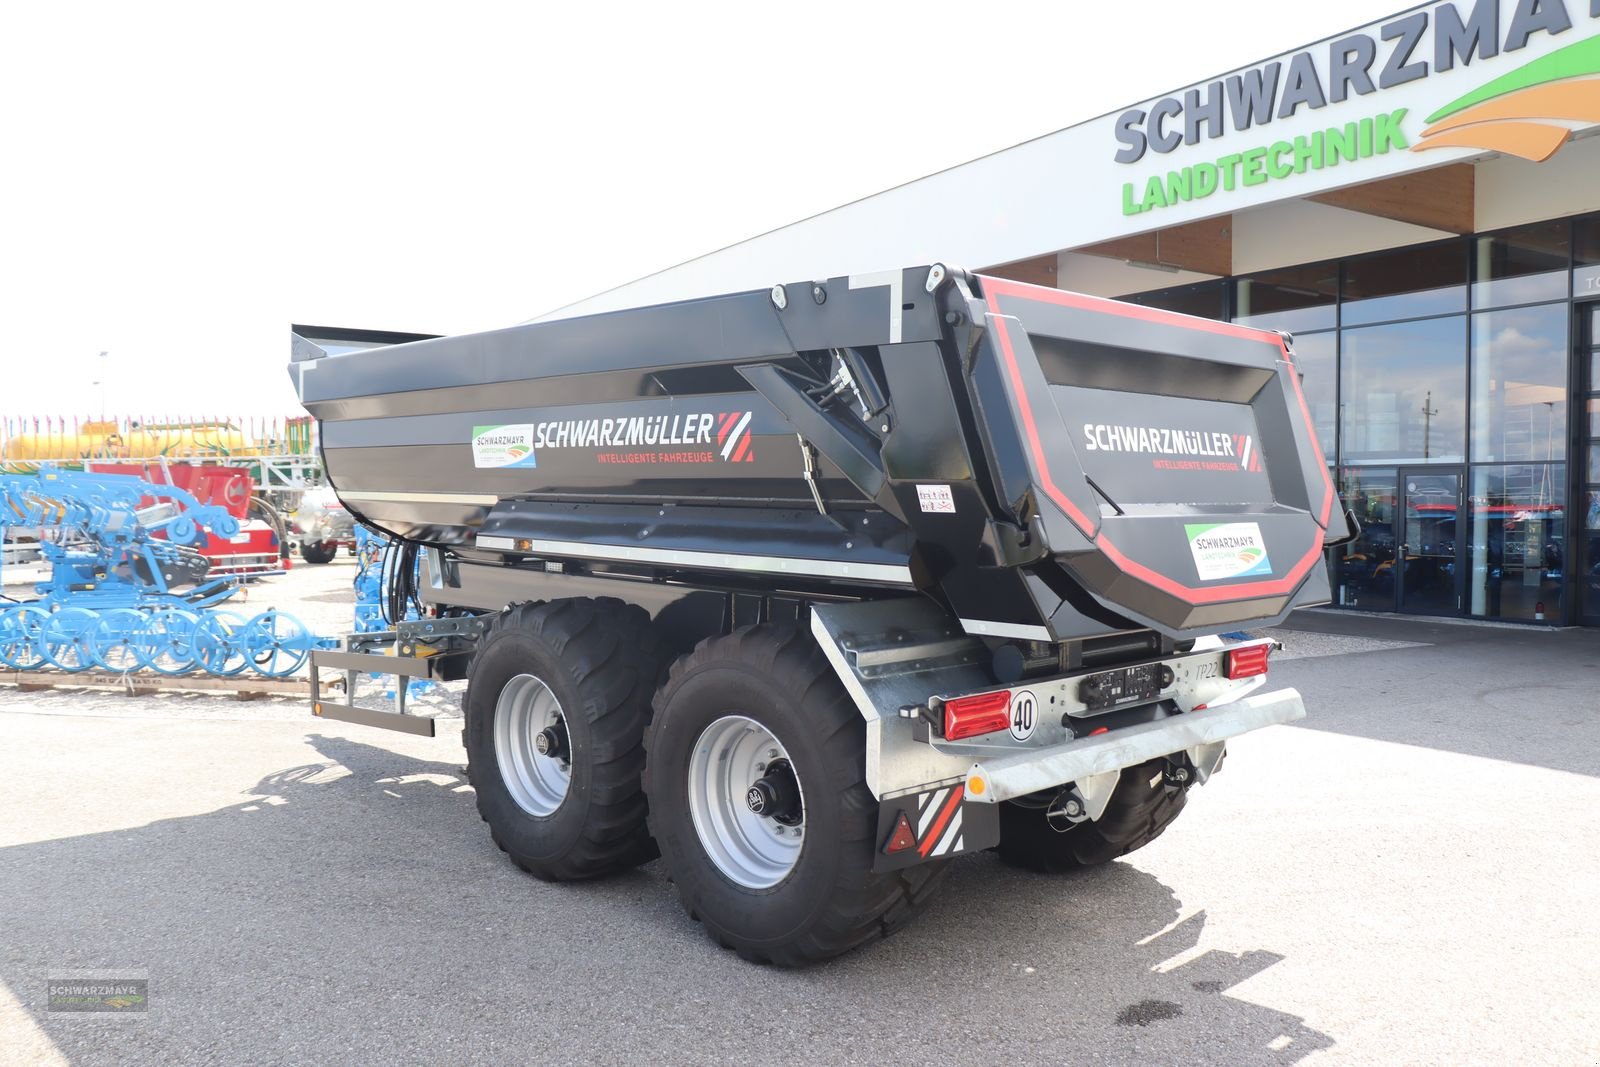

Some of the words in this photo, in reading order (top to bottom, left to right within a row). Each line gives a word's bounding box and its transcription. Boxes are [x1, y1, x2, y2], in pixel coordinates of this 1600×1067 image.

[1114, 0, 1600, 165] SCHWARZMA
[1122, 107, 1411, 216] LANDTECHNIK
[476, 435, 525, 446] SCHWARZMAYR
[534, 413, 714, 449] SCHWARZMÜLLER
[1084, 423, 1235, 456] SCHWARZMÜLLER
[597, 452, 657, 464] INTELLIGENTE
[658, 451, 713, 463] FAHRZEUGE
[1195, 536, 1255, 550] SCHWARZMAYR
[1196, 661, 1218, 680] TP22
[1014, 698, 1032, 732] 40
